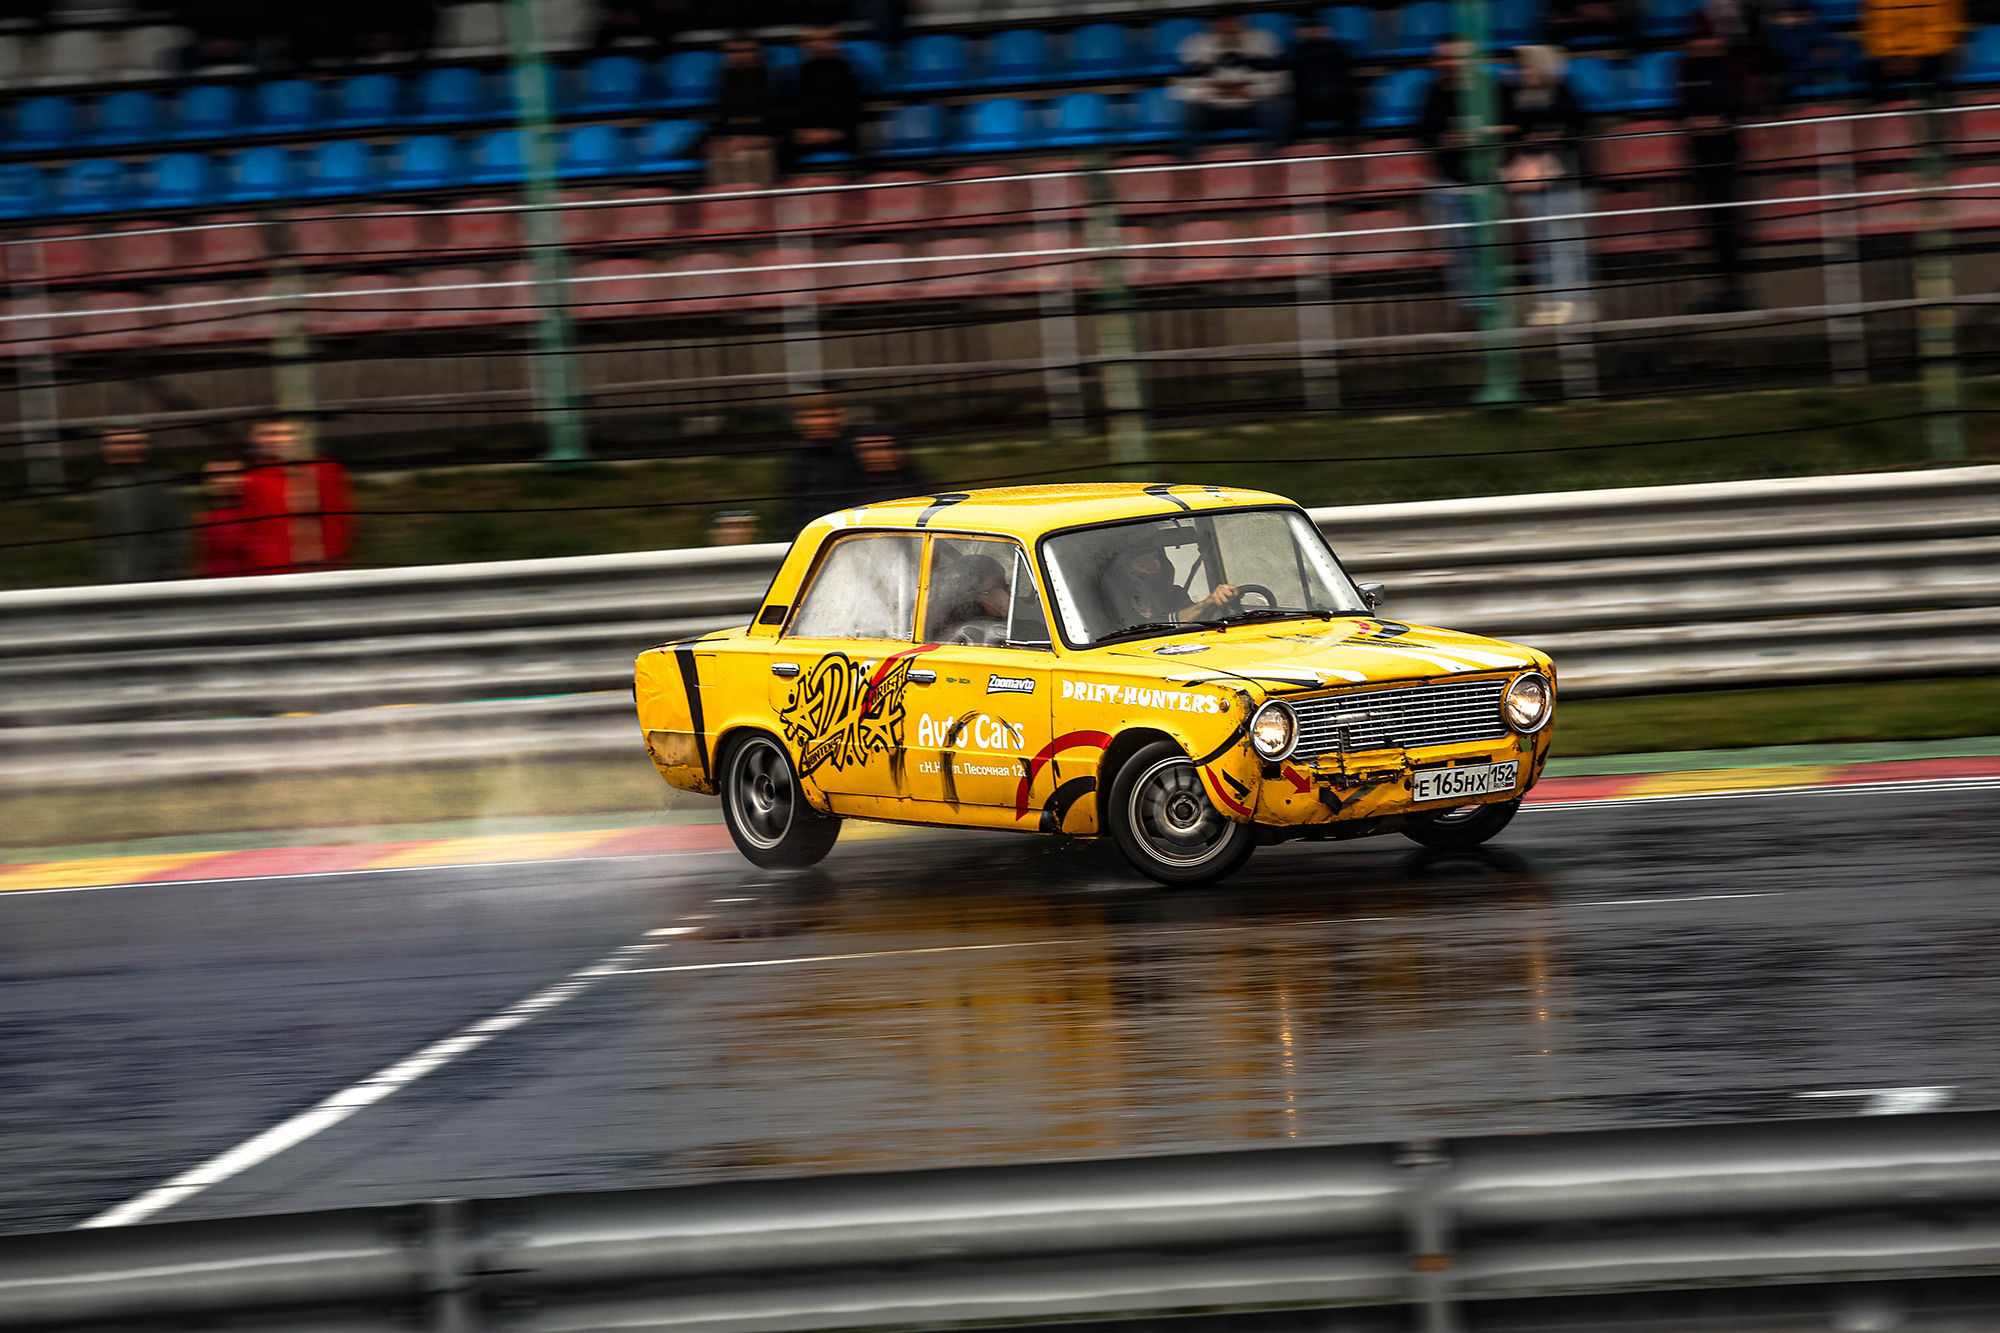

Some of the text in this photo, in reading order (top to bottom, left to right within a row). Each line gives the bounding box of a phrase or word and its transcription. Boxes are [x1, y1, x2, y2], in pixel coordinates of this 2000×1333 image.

[988, 674, 1035, 690] Zoomavto
[1061, 679, 1219, 714] DRIFT-HUNTERS
[975, 714, 1025, 750] Cars
[964, 762, 1010, 779] Песочная
[1490, 764, 1514, 783] 152
